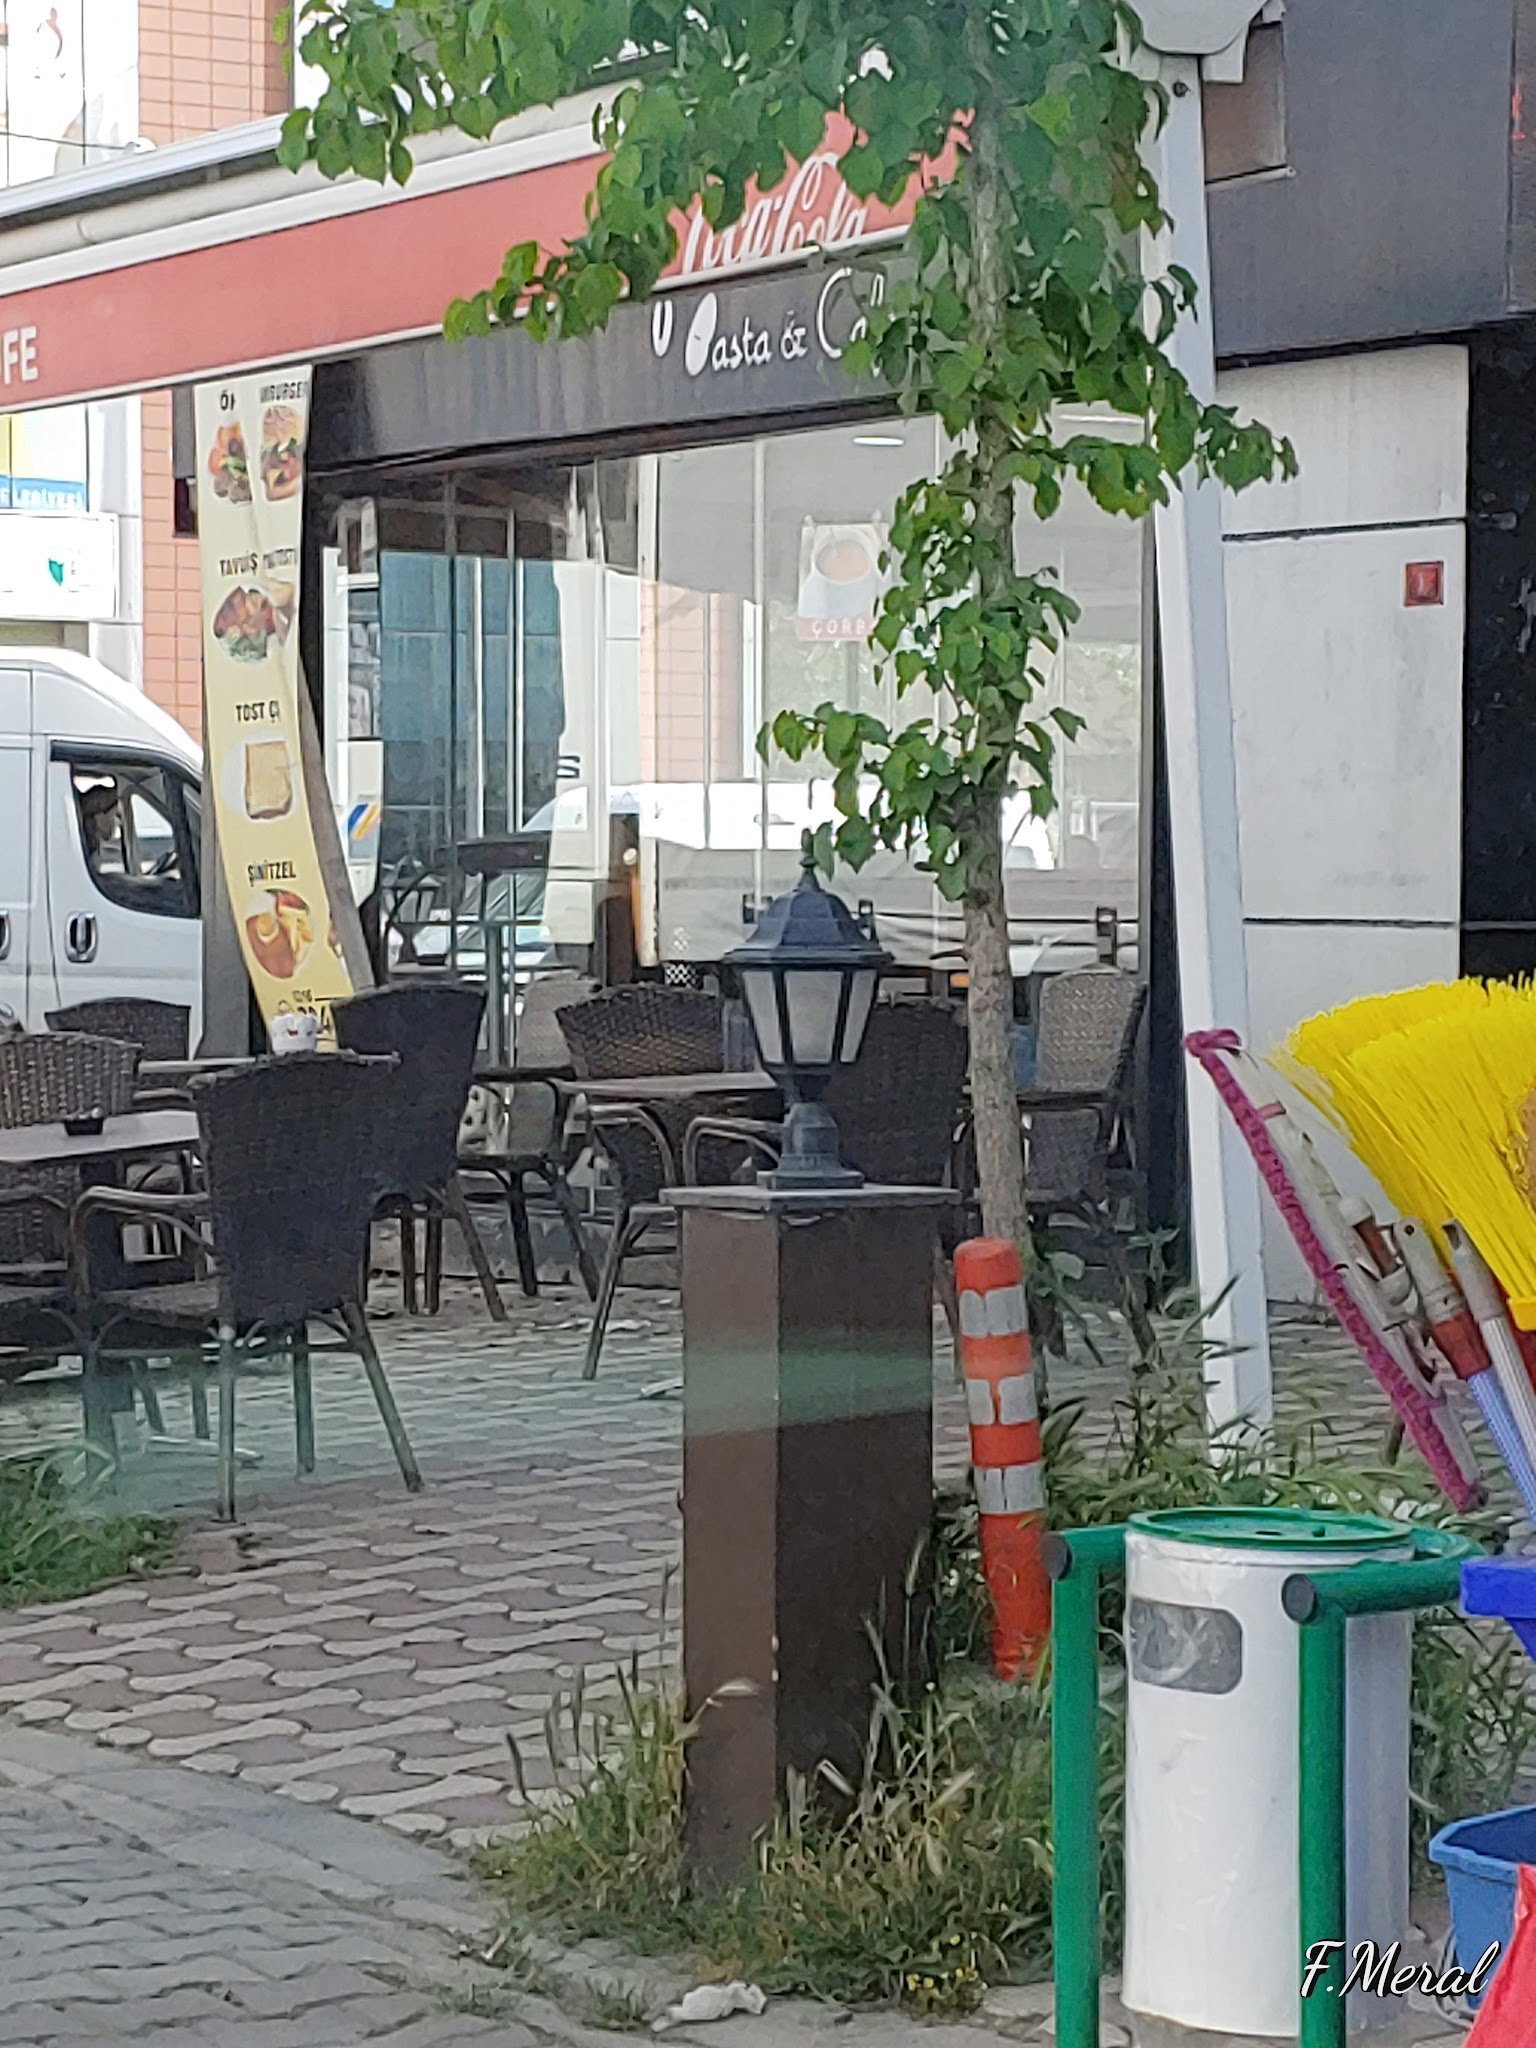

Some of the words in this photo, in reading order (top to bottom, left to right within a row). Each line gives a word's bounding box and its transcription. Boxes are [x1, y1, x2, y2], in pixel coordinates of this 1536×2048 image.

[780, 311, 809, 361] &
[0, 326, 38, 385] FE
[812, 619, 866, 638] ÇORB
[236, 702, 265, 722] TOST
